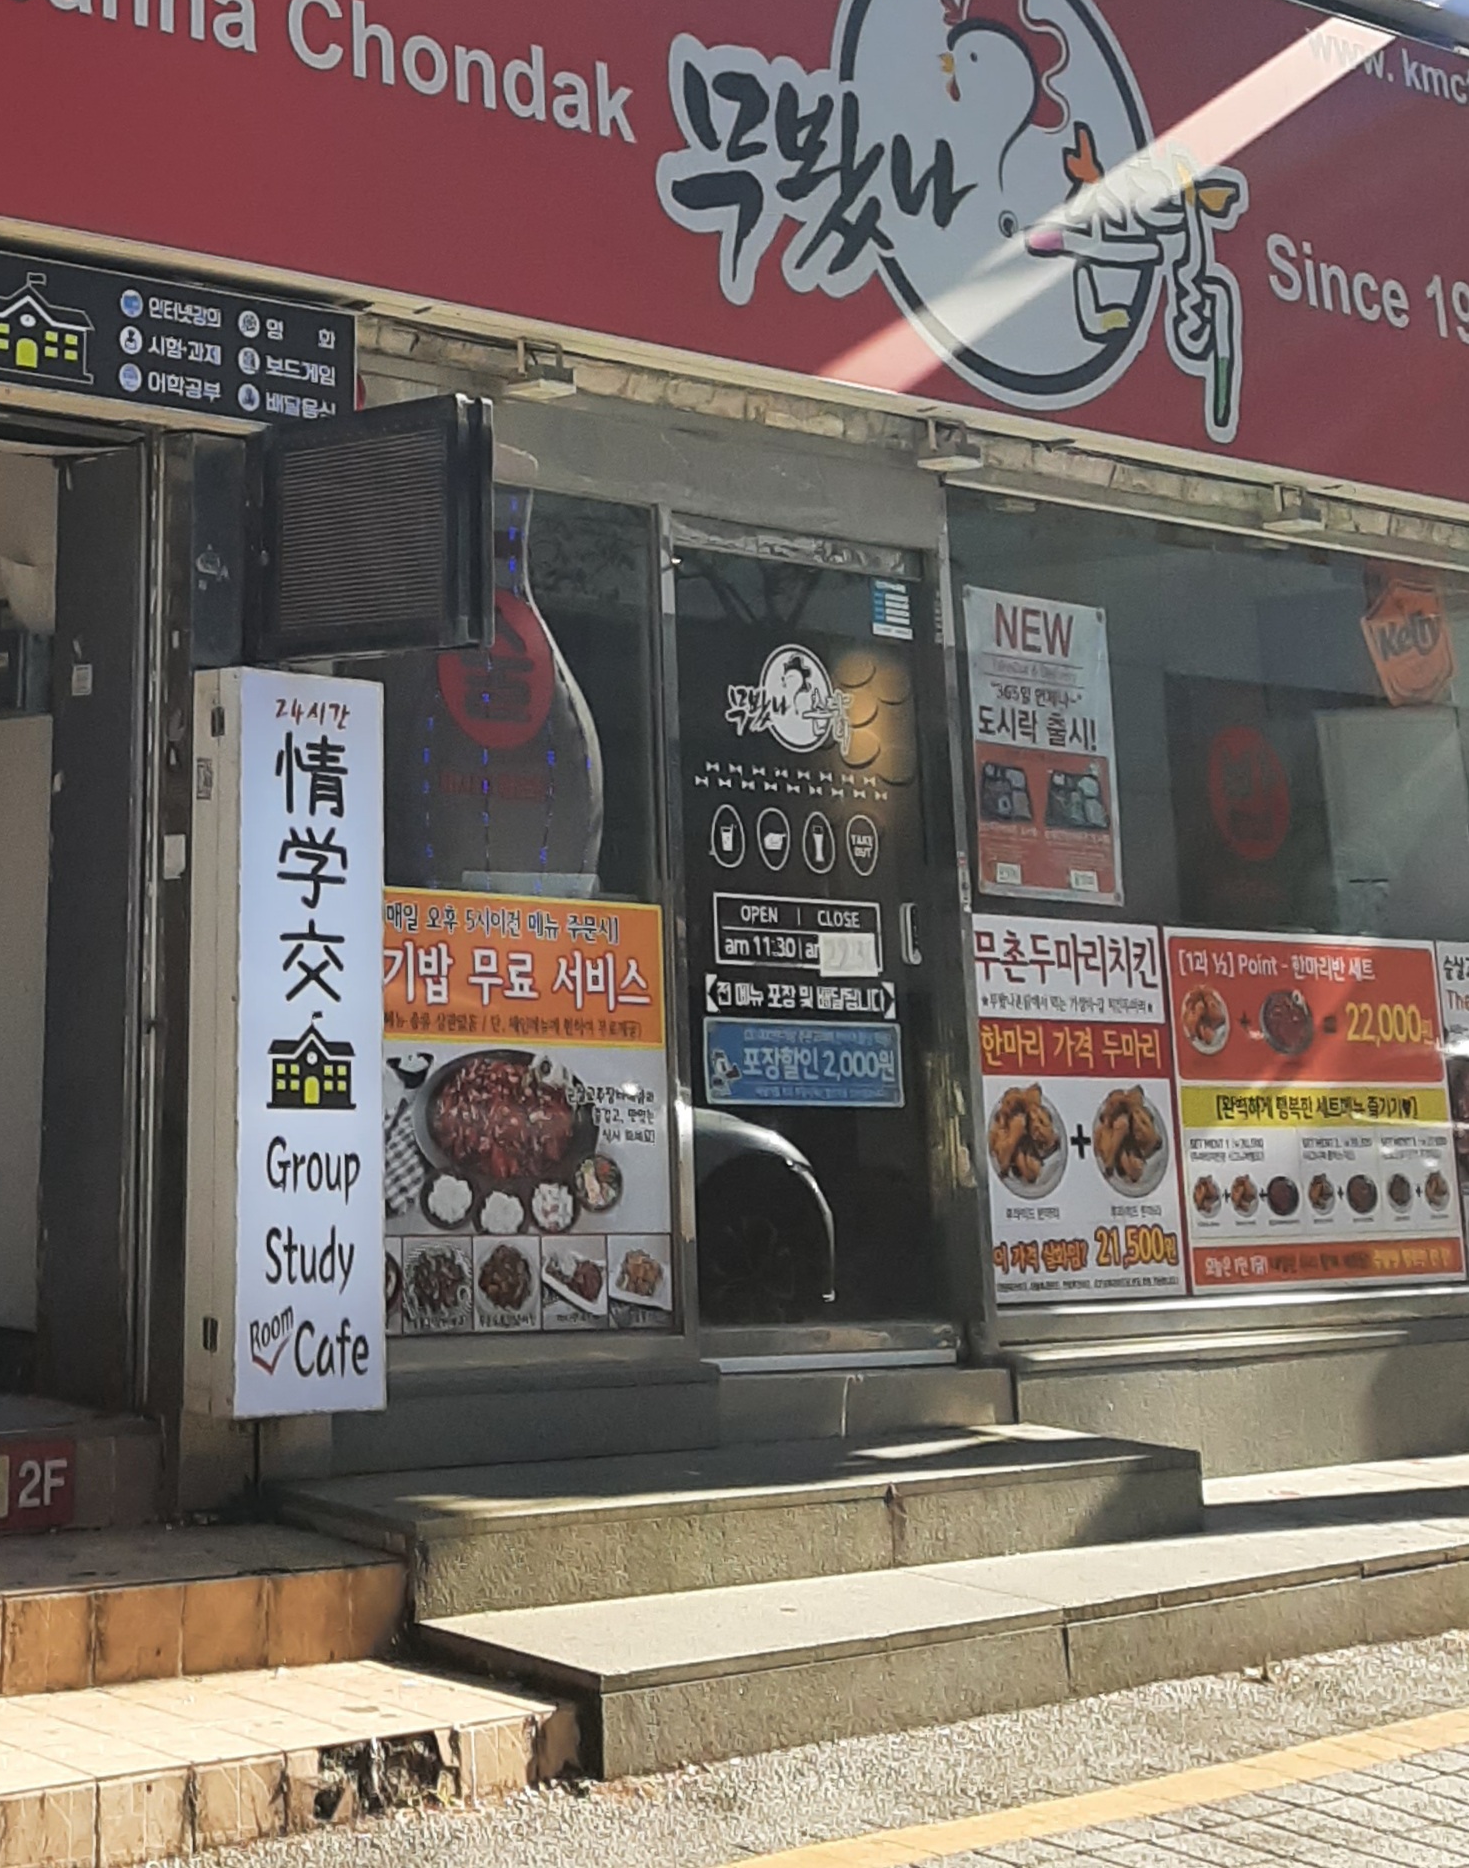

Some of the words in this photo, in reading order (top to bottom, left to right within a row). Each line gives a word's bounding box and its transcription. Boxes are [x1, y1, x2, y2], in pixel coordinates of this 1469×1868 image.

[1401, 47, 1469, 106] kmc
[1266, 232, 1411, 328] Since
[148, 296, 222, 328] 인터넷강의
[147, 371, 222, 403] 어학공부
[265, 354, 336, 387] 보드게임
[995, 603, 1074, 658] NEW
[275, 697, 351, 730] 24시간
[978, 704, 1038, 744] 도시락
[1046, 712, 1097, 752] 출시!
[426, 905, 459, 934] 오후
[527, 911, 560, 940] 메뉴
[740, 905, 779, 924] OPEN
[817, 909, 861, 929] CLOSE
[724, 938, 749, 957] am
[753, 935, 797, 959] 11:30
[974, 930, 1159, 989] 무촌두마리치킨
[1237, 953, 1278, 978] Point
[1348, 956, 1376, 982] 세트
[467, 947, 541, 1006] 무료
[551, 949, 653, 1011] 서비스
[767, 982, 797, 1009] 포장
[742, 1046, 820, 1081] 포장할인
[822, 1048, 896, 1082] 2,000원
[981, 1023, 1046, 1069] 한마리
[1052, 1026, 1095, 1070] 가격
[1101, 1028, 1162, 1070] 두마리
[266, 1134, 361, 1206] Group
[265, 1224, 355, 1295] Study
[1093, 1223, 1180, 1270] 21,500원
[294, 1317, 370, 1379] Cafe
[17, 1458, 68, 1510] 2F
